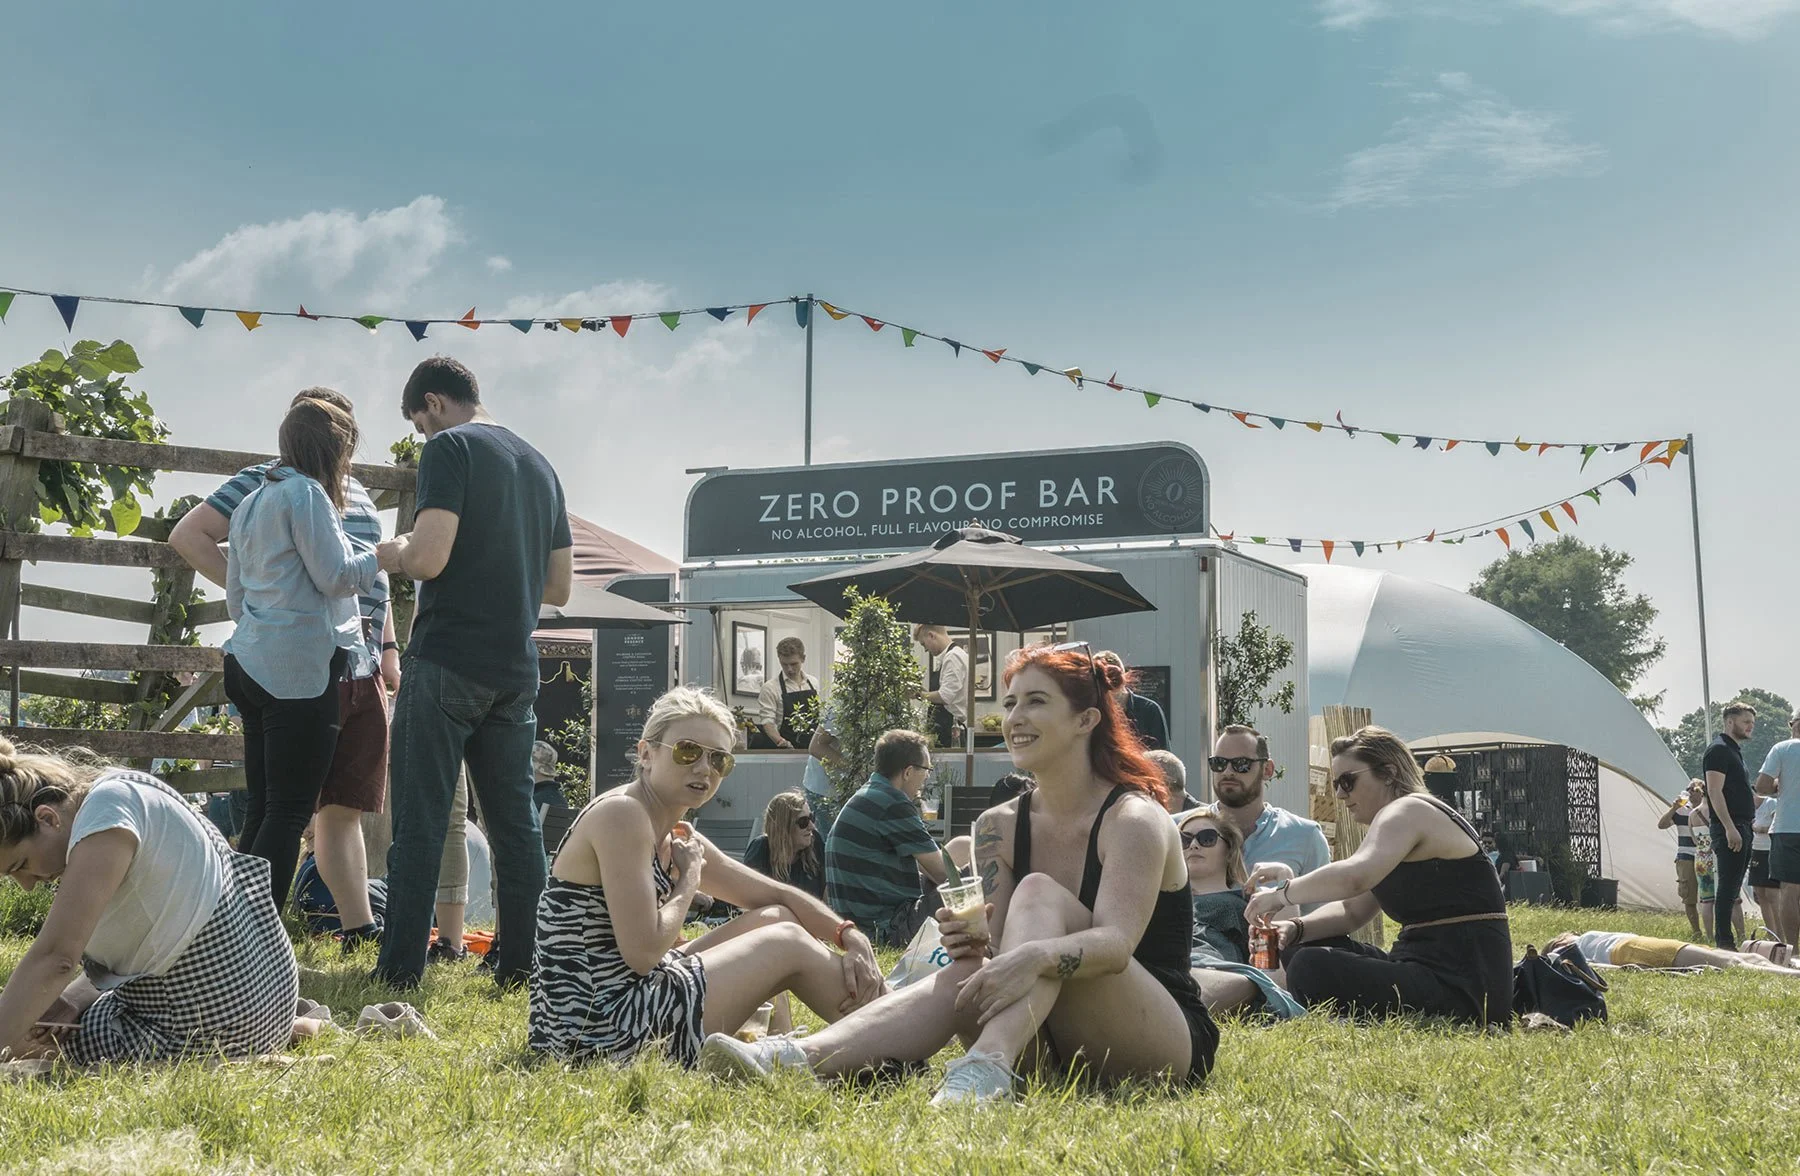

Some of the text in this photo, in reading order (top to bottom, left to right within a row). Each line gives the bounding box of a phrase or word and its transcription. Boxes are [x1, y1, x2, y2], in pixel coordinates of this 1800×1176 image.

[759, 476, 1119, 522] ZERO PROOF BAR
[771, 529, 793, 541] NO
[797, 525, 867, 539] ALCOHOL,
[871, 523, 903, 535] FULL
[980, 518, 1003, 532] NO
[1008, 513, 1104, 529] COMPROMISE
[1153, 508, 1195, 522] ALCOHOL
